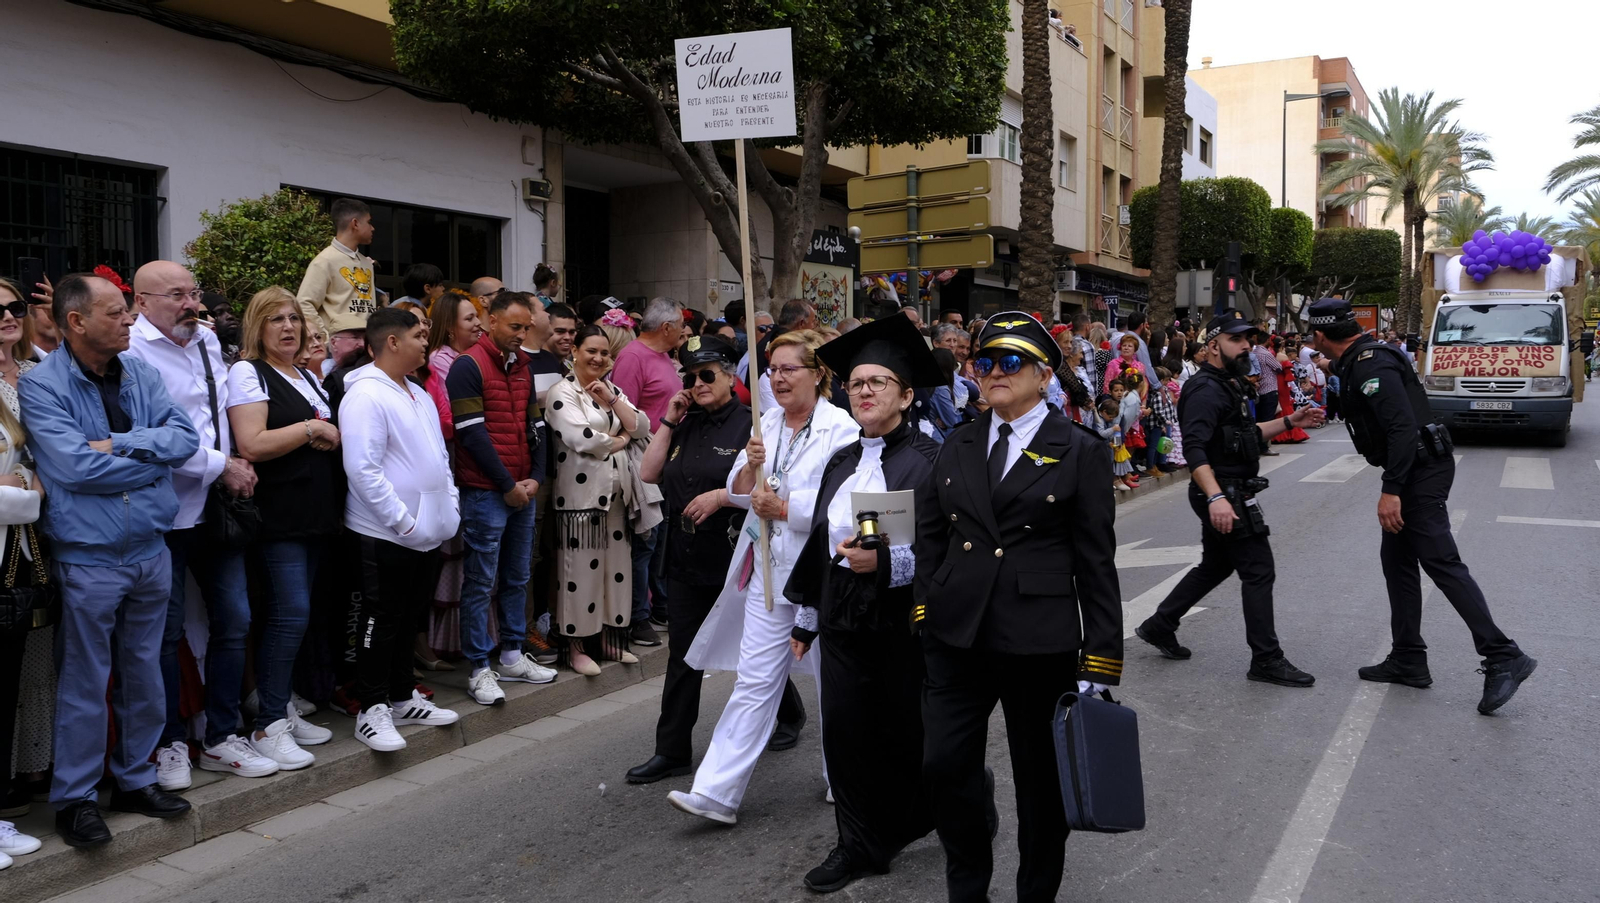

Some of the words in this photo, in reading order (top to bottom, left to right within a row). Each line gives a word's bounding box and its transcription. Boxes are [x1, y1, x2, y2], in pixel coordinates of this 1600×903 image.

[685, 42, 736, 67] Edad
[697, 65, 782, 90] Moderna
[687, 98, 702, 106] ESTA
[705, 95, 735, 105] HISTORIA
[741, 94, 749, 102] ES
[752, 90, 789, 101] NECESARIA
[712, 108, 728, 116] PARA
[736, 104, 769, 115] ENTENDER
[704, 119, 734, 129] NUESTRO
[740, 116, 774, 126] PRESENTE
[1446, 333, 1453, 341] 7
[1433, 346, 1485, 354] CLASES
[1434, 354, 1463, 362] HAY
[1433, 360, 1483, 372] BUENO
[1502, 359, 1545, 368] OTRO
[1463, 367, 1520, 377] MEJOR
